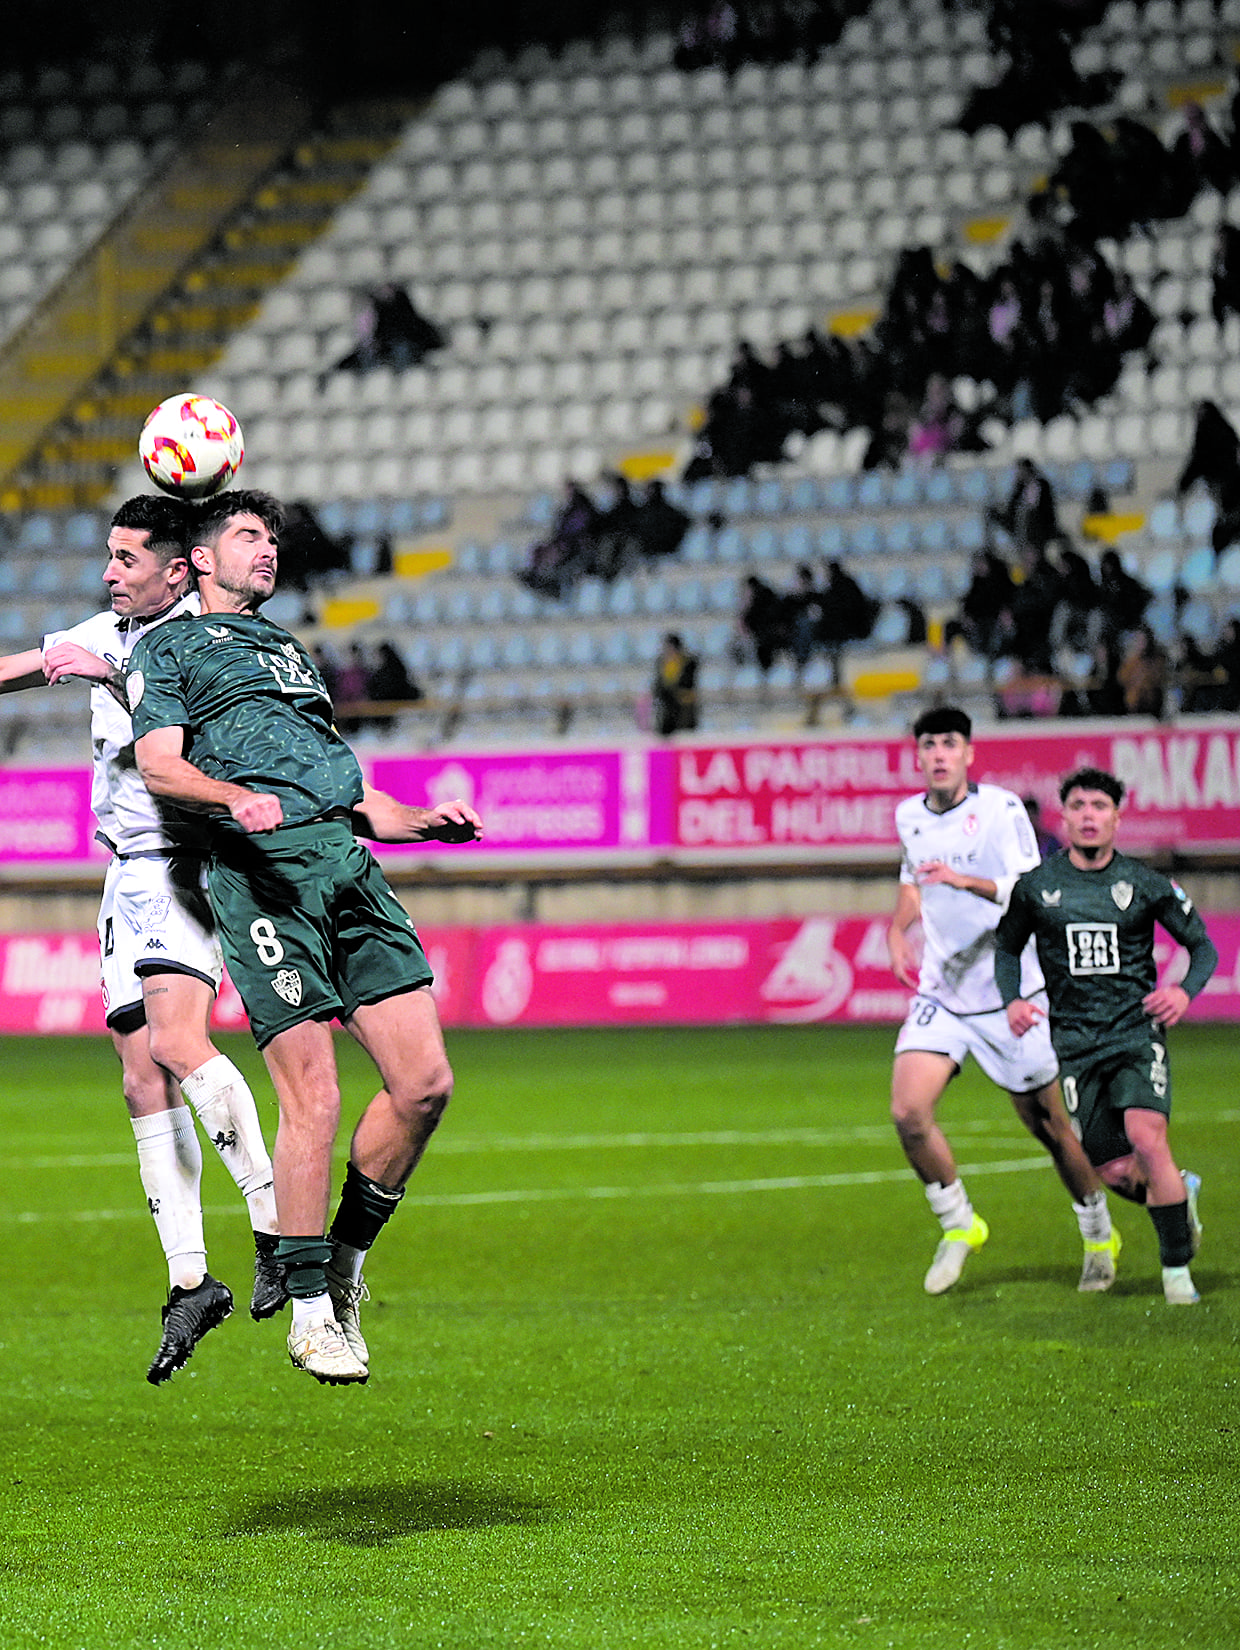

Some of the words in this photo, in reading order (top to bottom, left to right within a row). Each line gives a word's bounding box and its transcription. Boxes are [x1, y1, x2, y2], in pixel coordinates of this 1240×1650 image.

[679, 750, 741, 795] LA
[743, 744, 927, 792] PARRILL
[1112, 735, 1240, 810] PAKA
[678, 799, 768, 844] DEL
[771, 787, 899, 841] HÚME
[250, 918, 285, 966] 8
